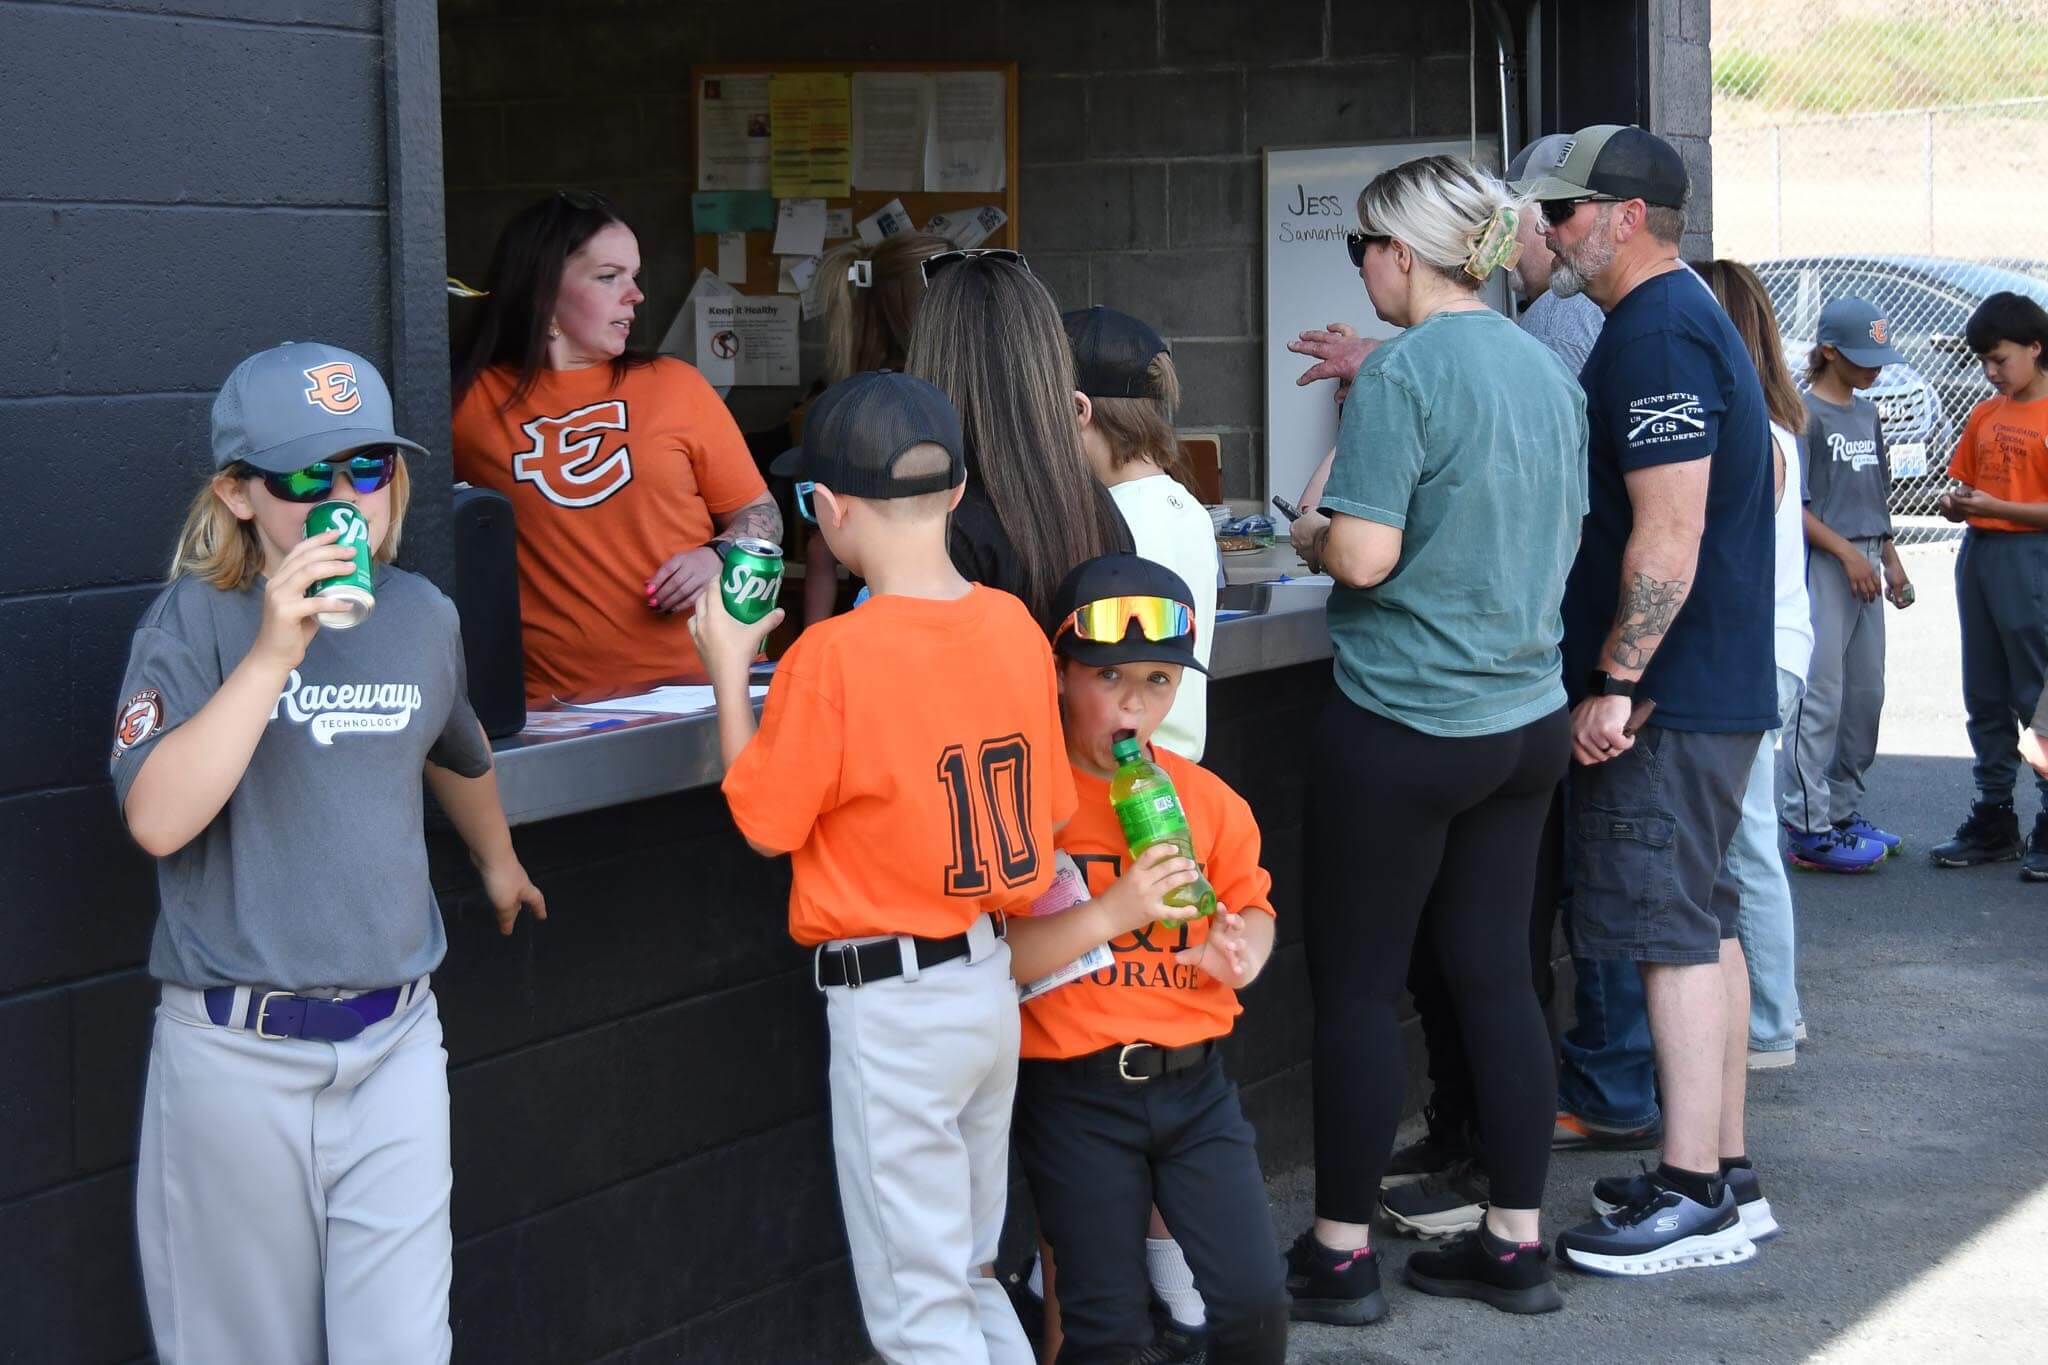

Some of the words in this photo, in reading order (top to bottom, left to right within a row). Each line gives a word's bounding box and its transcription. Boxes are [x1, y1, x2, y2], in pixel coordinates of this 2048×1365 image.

[1287, 184, 1343, 216] JESS
[1279, 222, 1360, 243] Samanth
[708, 306, 734, 316] Keep
[736, 306, 743, 314] it
[744, 305, 779, 316] Healthy
[1630, 395, 1665, 408] GRUNT
[1667, 392, 1699, 401] STYLE
[1651, 421, 1677, 434] GS
[1672, 431, 1705, 440] DEFEND
[1827, 433, 1877, 461] Racew
[269, 668, 422, 723] Raceways
[320, 718, 400, 728] TECHNOLOGY
[937, 732, 1040, 898] 10
[1072, 961, 1198, 990] ORAGE
